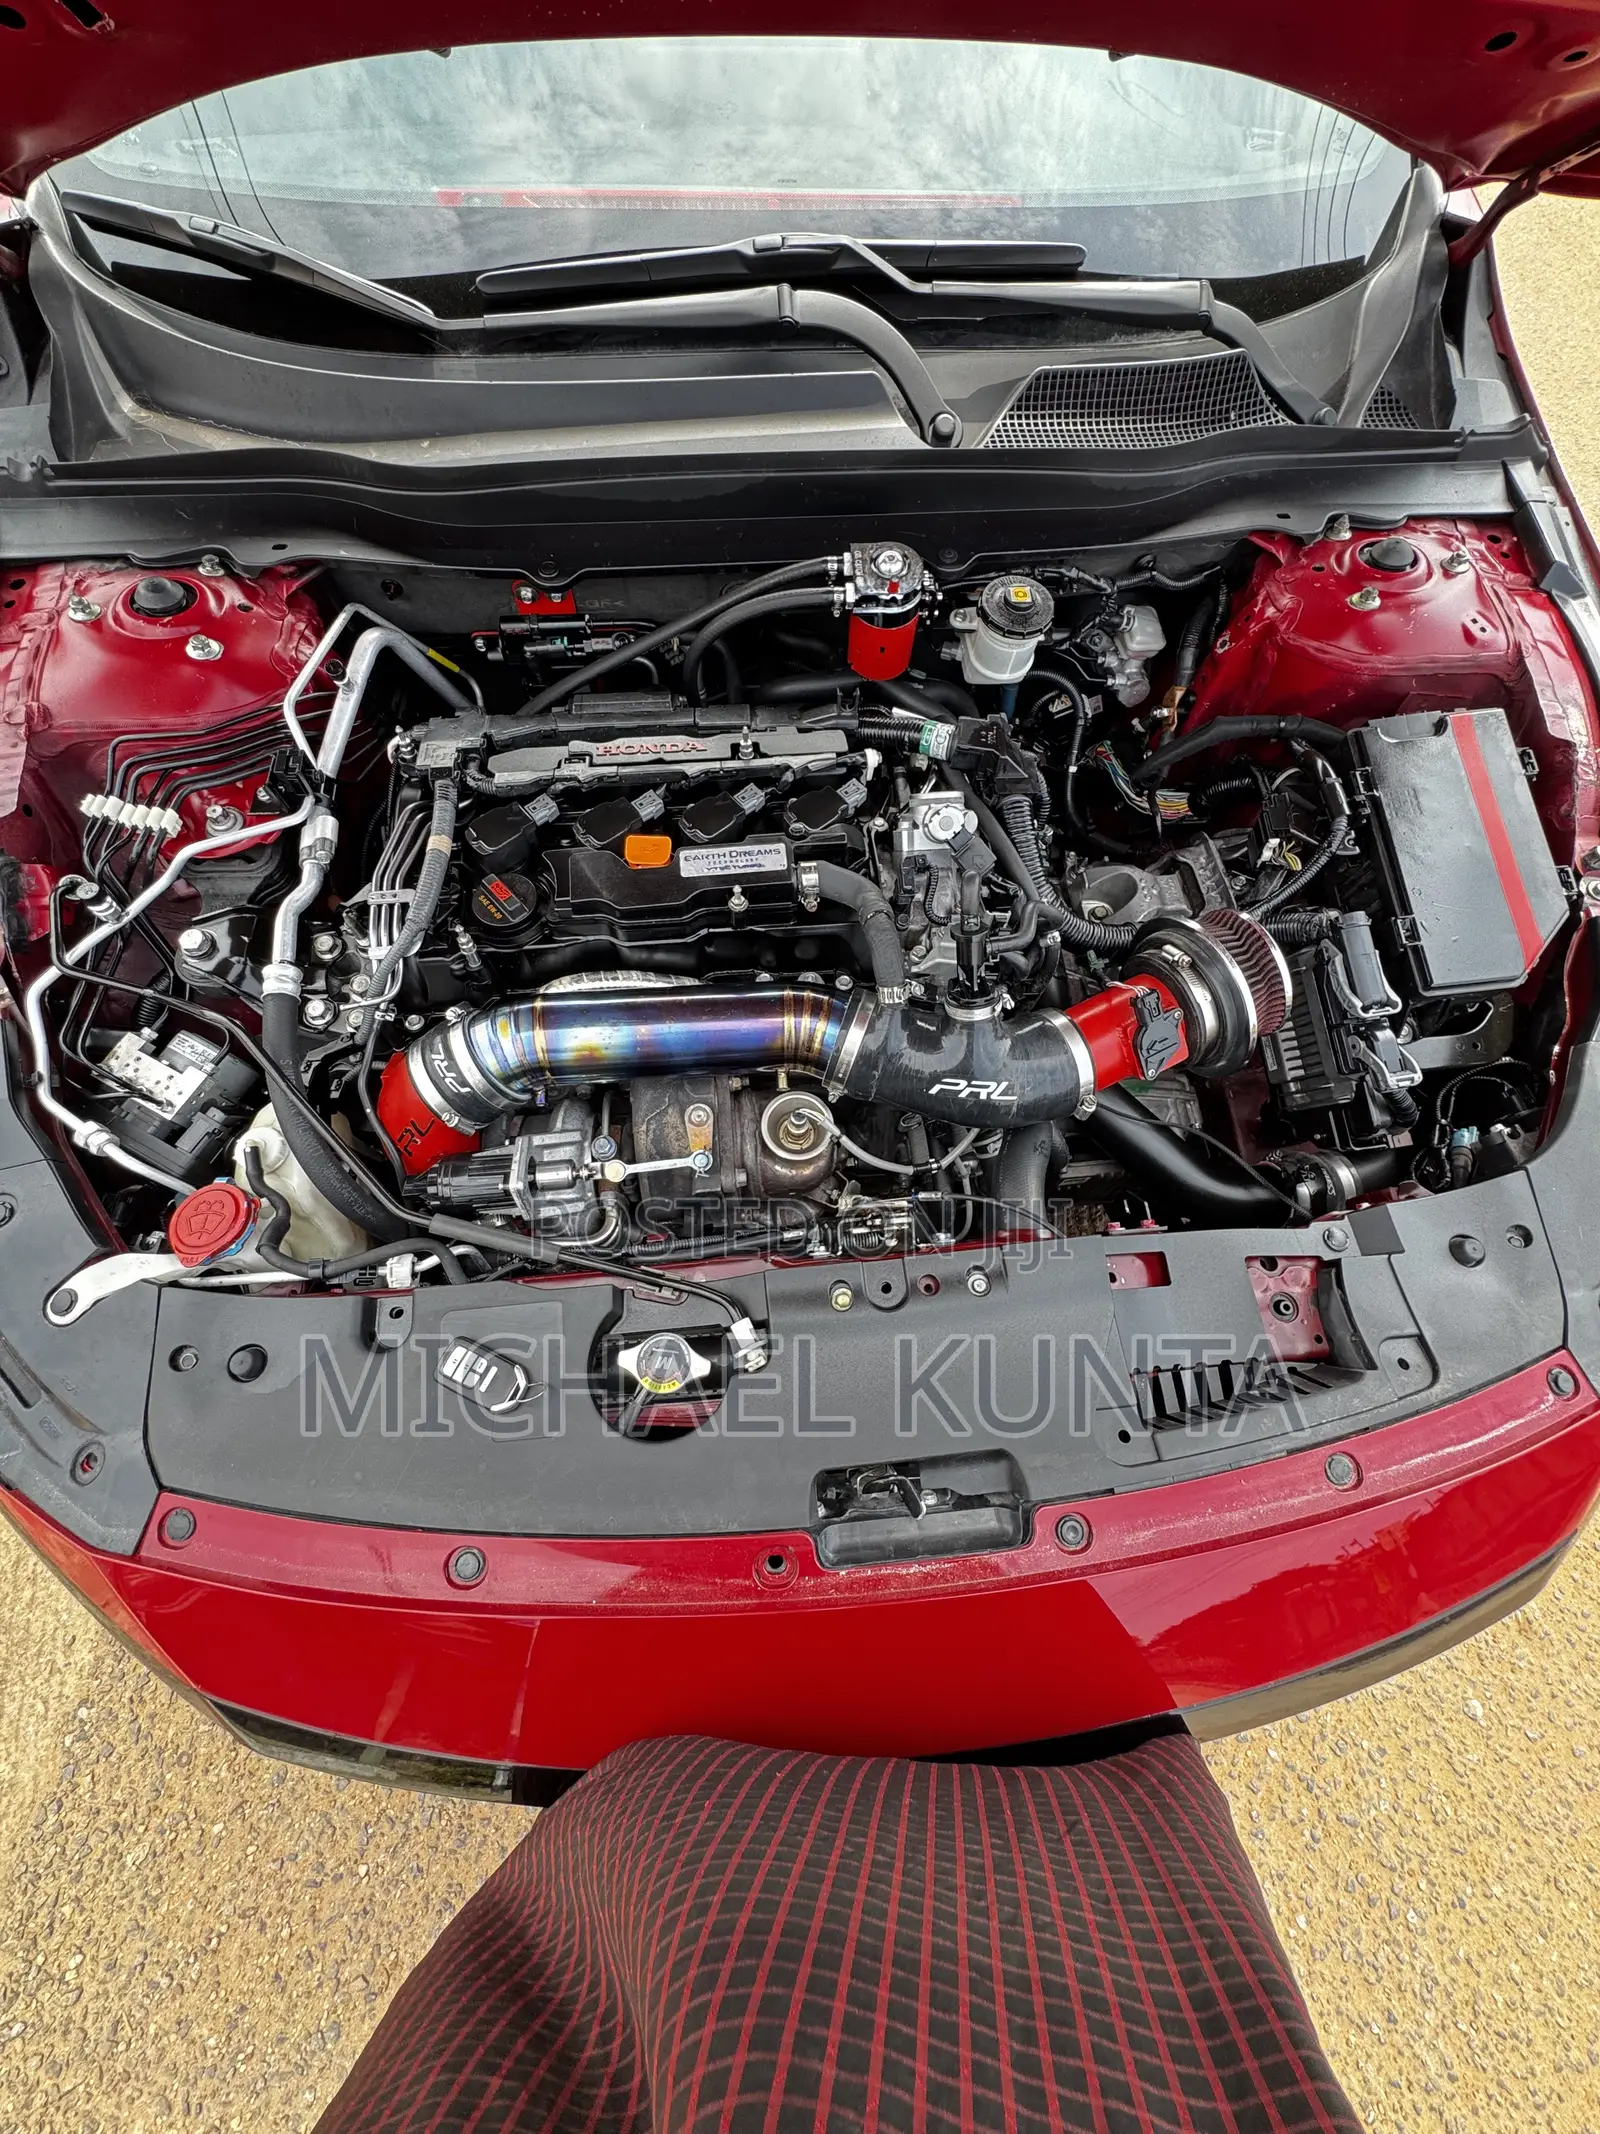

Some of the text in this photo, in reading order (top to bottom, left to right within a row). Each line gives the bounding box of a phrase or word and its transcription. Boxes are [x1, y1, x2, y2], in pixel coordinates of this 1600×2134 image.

[596, 741, 707, 756] HONDA
[684, 848, 781, 862] EARTH DREAMS
[708, 857, 759, 865] TECHNOLOGY
[479, 895, 490, 907] SAE
[431, 1043, 472, 1093] PRL
[928, 1078, 1018, 1100] PRL
[397, 1117, 435, 1157] RL
